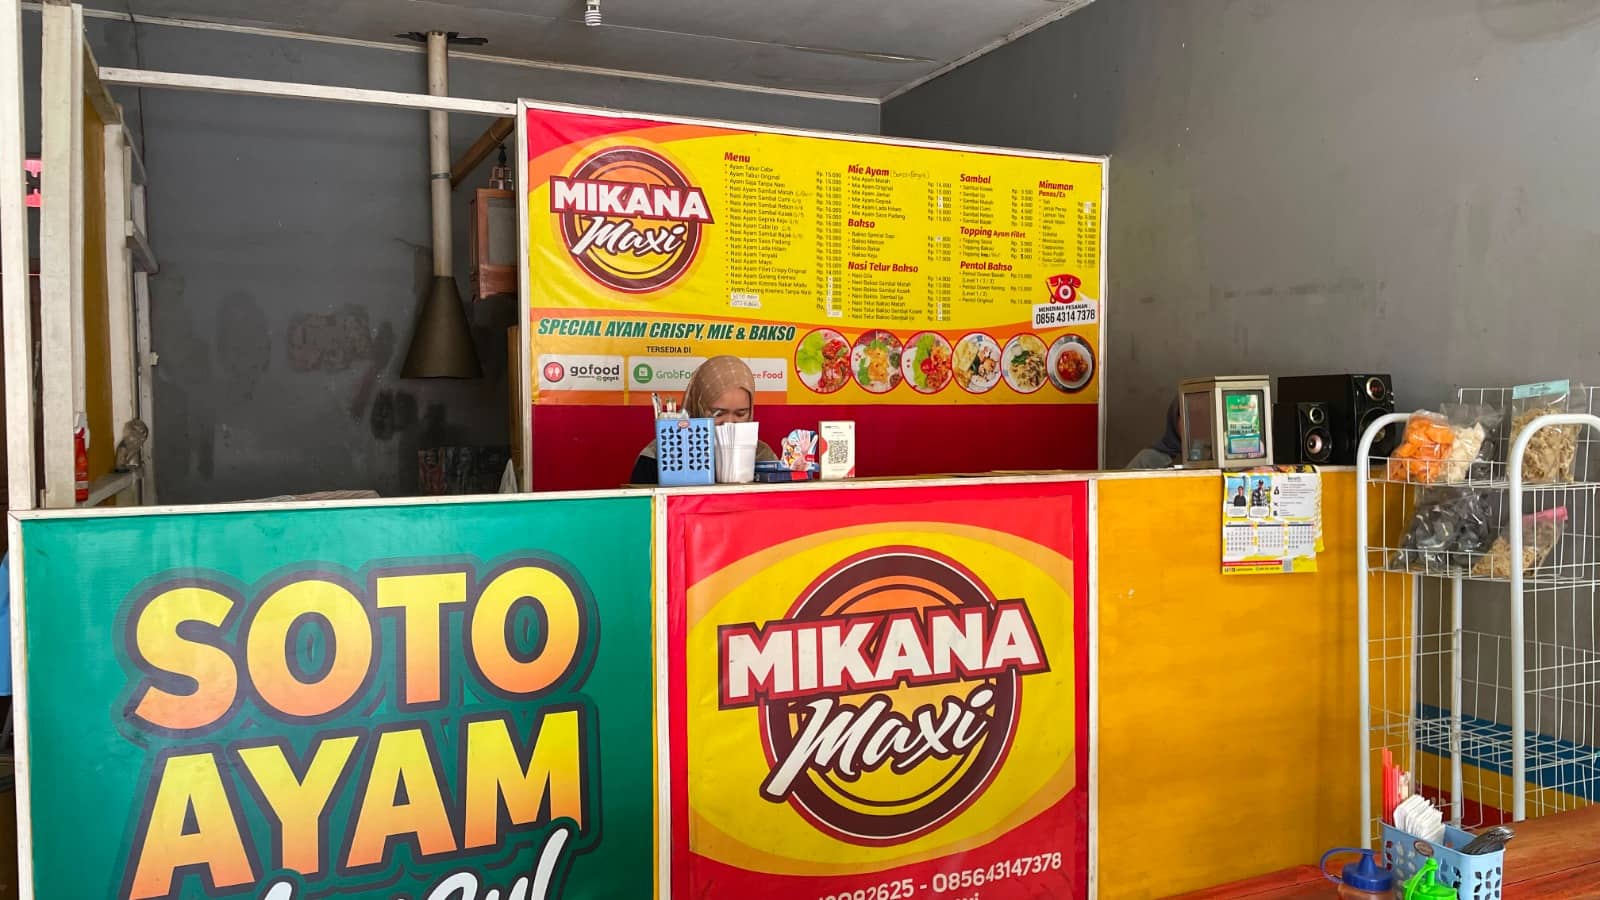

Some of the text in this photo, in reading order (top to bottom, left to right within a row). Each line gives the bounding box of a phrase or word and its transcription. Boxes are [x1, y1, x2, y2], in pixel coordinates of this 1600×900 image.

[724, 152, 751, 163] Menu
[847, 164, 864, 174] Mie
[865, 166, 890, 177] Ayam
[960, 173, 991, 184] Sambal
[1039, 179, 1074, 191] Minuman
[554, 181, 708, 219] MIKANA
[847, 218, 875, 228] Bakso
[572, 216, 685, 256] Maxi
[960, 226, 993, 238] Topping
[993, 230, 1010, 238] Ayam
[847, 261, 919, 273] Nasi Telur Bakso
[960, 261, 1013, 272] Pentol Bakso
[1036, 309, 1095, 325] 0856 4314 7378
[538, 319, 795, 342] SPECIAL AYAM CRISPY, MIE & BAKSO
[646, 346, 682, 354] TERSEDIA
[570, 364, 620, 376] gofood
[134, 566, 580, 730] SOTO
[728, 609, 1040, 698] MIKANA
[766, 689, 994, 796] Maxi
[128, 710, 583, 900] AYAM
[932, 851, 1063, 893] 085643147378
